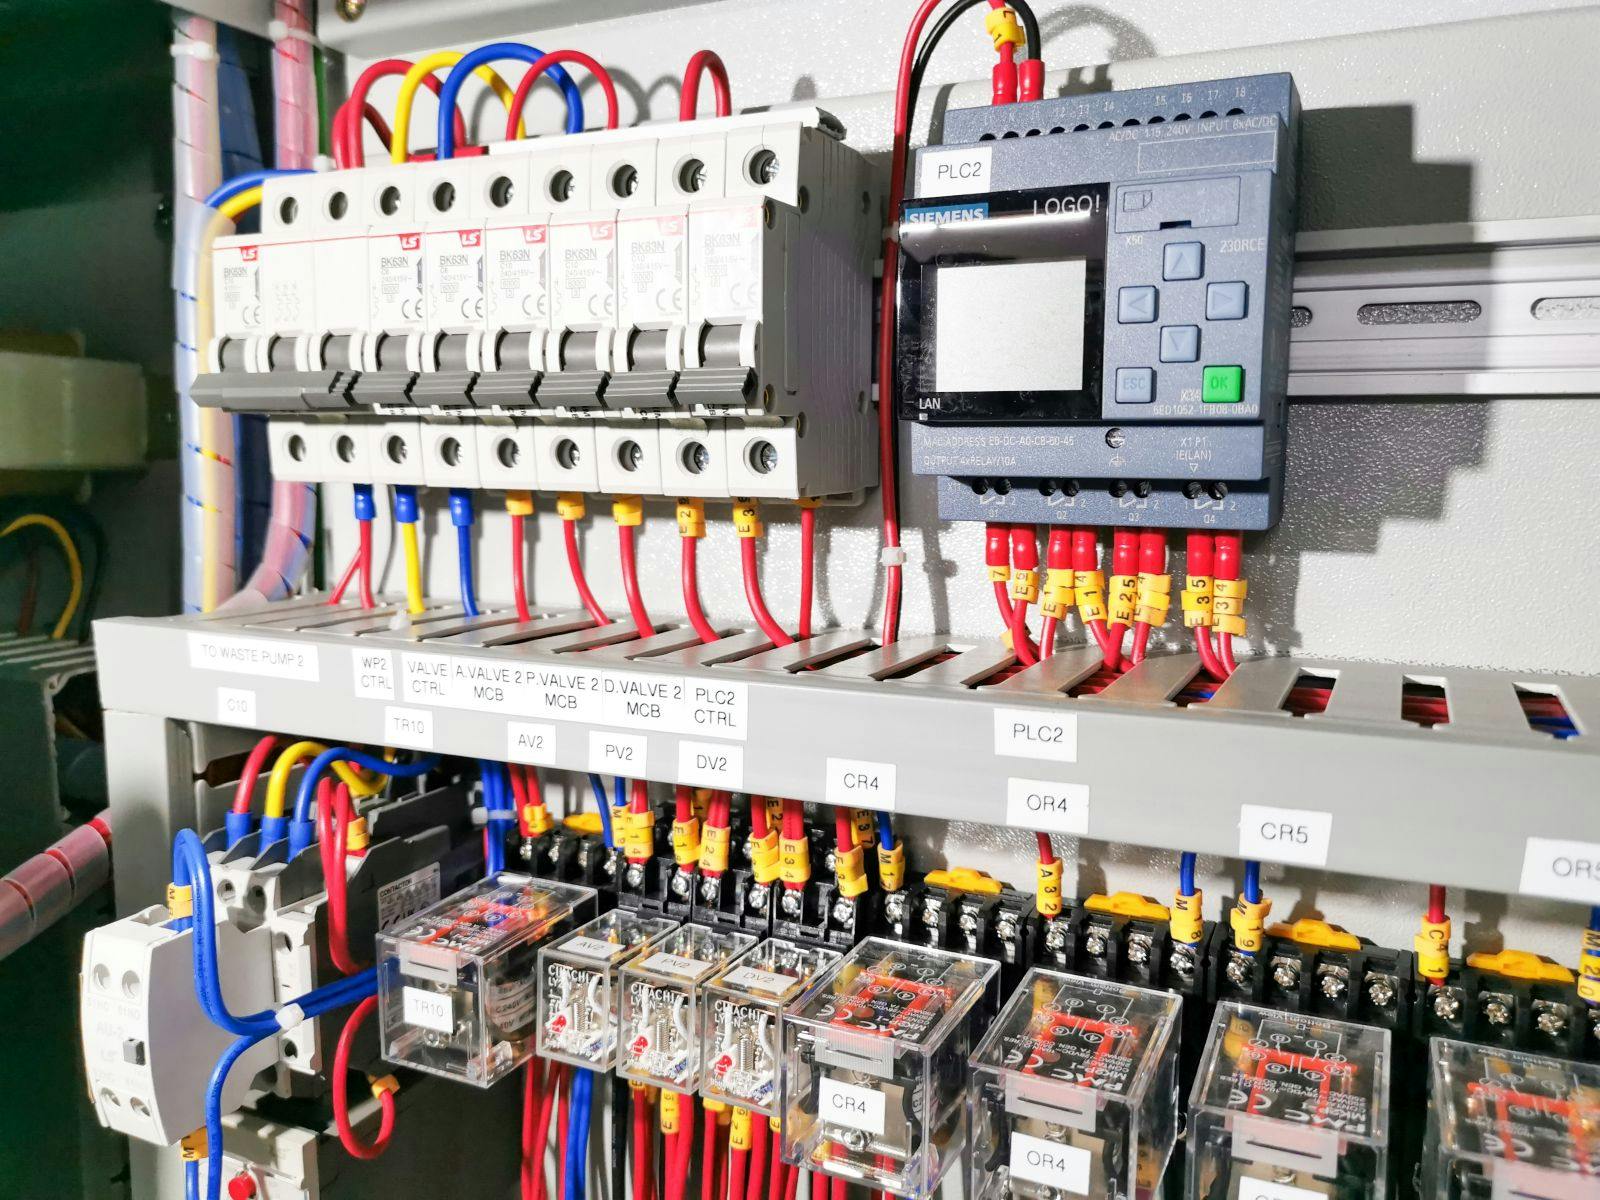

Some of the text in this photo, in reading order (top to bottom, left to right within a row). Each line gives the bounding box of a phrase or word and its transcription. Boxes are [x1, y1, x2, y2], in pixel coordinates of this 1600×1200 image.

[1197, 120, 1229, 133] INPUT
[937, 161, 982, 179] PLC2
[909, 208, 985, 224] SIEMENS
[500, 249, 531, 261] BK63N
[565, 248, 597, 260] BK63N
[1219, 238, 1265, 253] 230RCE
[440, 254, 469, 266] BK63N
[1122, 377, 1146, 390] ESC
[1210, 376, 1228, 390] OK
[919, 398, 941, 410] LAN
[1203, 514, 1216, 524] Q4
[1116, 579, 1137, 621] E25
[1190, 579, 1211, 625] E35
[1213, 583, 1229, 627] E34
[202, 643, 305, 667] TO WASTE PUMP 2
[361, 656, 387, 671] WP2
[408, 660, 448, 677] VALVE
[456, 664, 523, 684] A.VALVE 2
[361, 675, 392, 691] CTRL
[412, 679, 446, 697] CTRL
[526, 671, 599, 692] P.VALVE 2
[605, 678, 682, 700] D.VALVE 2
[473, 685, 505, 702] MCB
[545, 692, 578, 710] MCB
[695, 687, 736, 706] PLC2
[626, 701, 661, 718] MCB
[694, 708, 737, 728] CTRL
[393, 717, 425, 734] TR10
[1013, 723, 1063, 743] PLC2
[517, 734, 544, 750] AV2
[605, 743, 634, 762] PV2
[696, 754, 728, 773] DV2
[843, 772, 879, 791] CR4
[1026, 793, 1068, 813] OR4
[1260, 821, 1309, 844] CR5
[702, 829, 716, 867] E24
[784, 844, 796, 880] E34
[1040, 867, 1058, 912] A32
[1427, 929, 1445, 974] C41
[630, 984, 676, 1005] CIACHI
[414, 998, 445, 1018] TR10
[714, 1000, 764, 1022] CIACHI
[855, 1020, 920, 1040] PMC
[1050, 1068, 1123, 1091] PMC
[831, 1093, 867, 1115] CR4
[1228, 1089, 1272, 1109] CE
[1284, 1110, 1366, 1133] PMC
[1026, 1150, 1067, 1173] OR4
